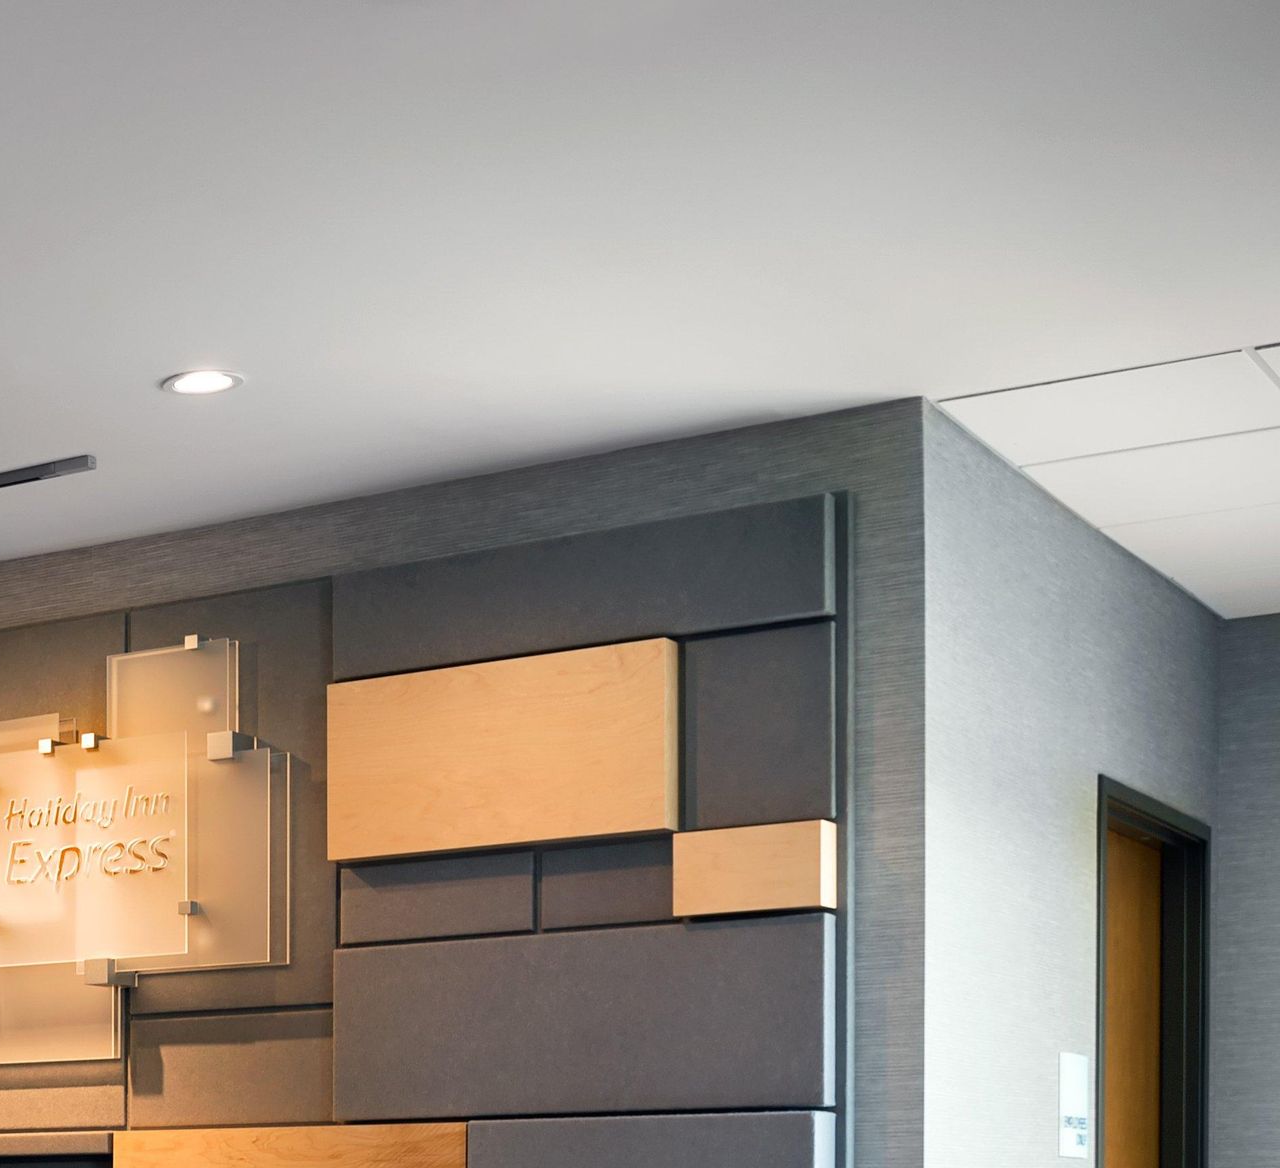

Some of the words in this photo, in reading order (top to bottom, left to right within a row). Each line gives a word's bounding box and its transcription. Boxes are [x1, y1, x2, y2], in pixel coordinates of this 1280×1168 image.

[5, 791, 118, 829] Holiday
[123, 784, 170, 820] Inn
[7, 833, 172, 893] Express
